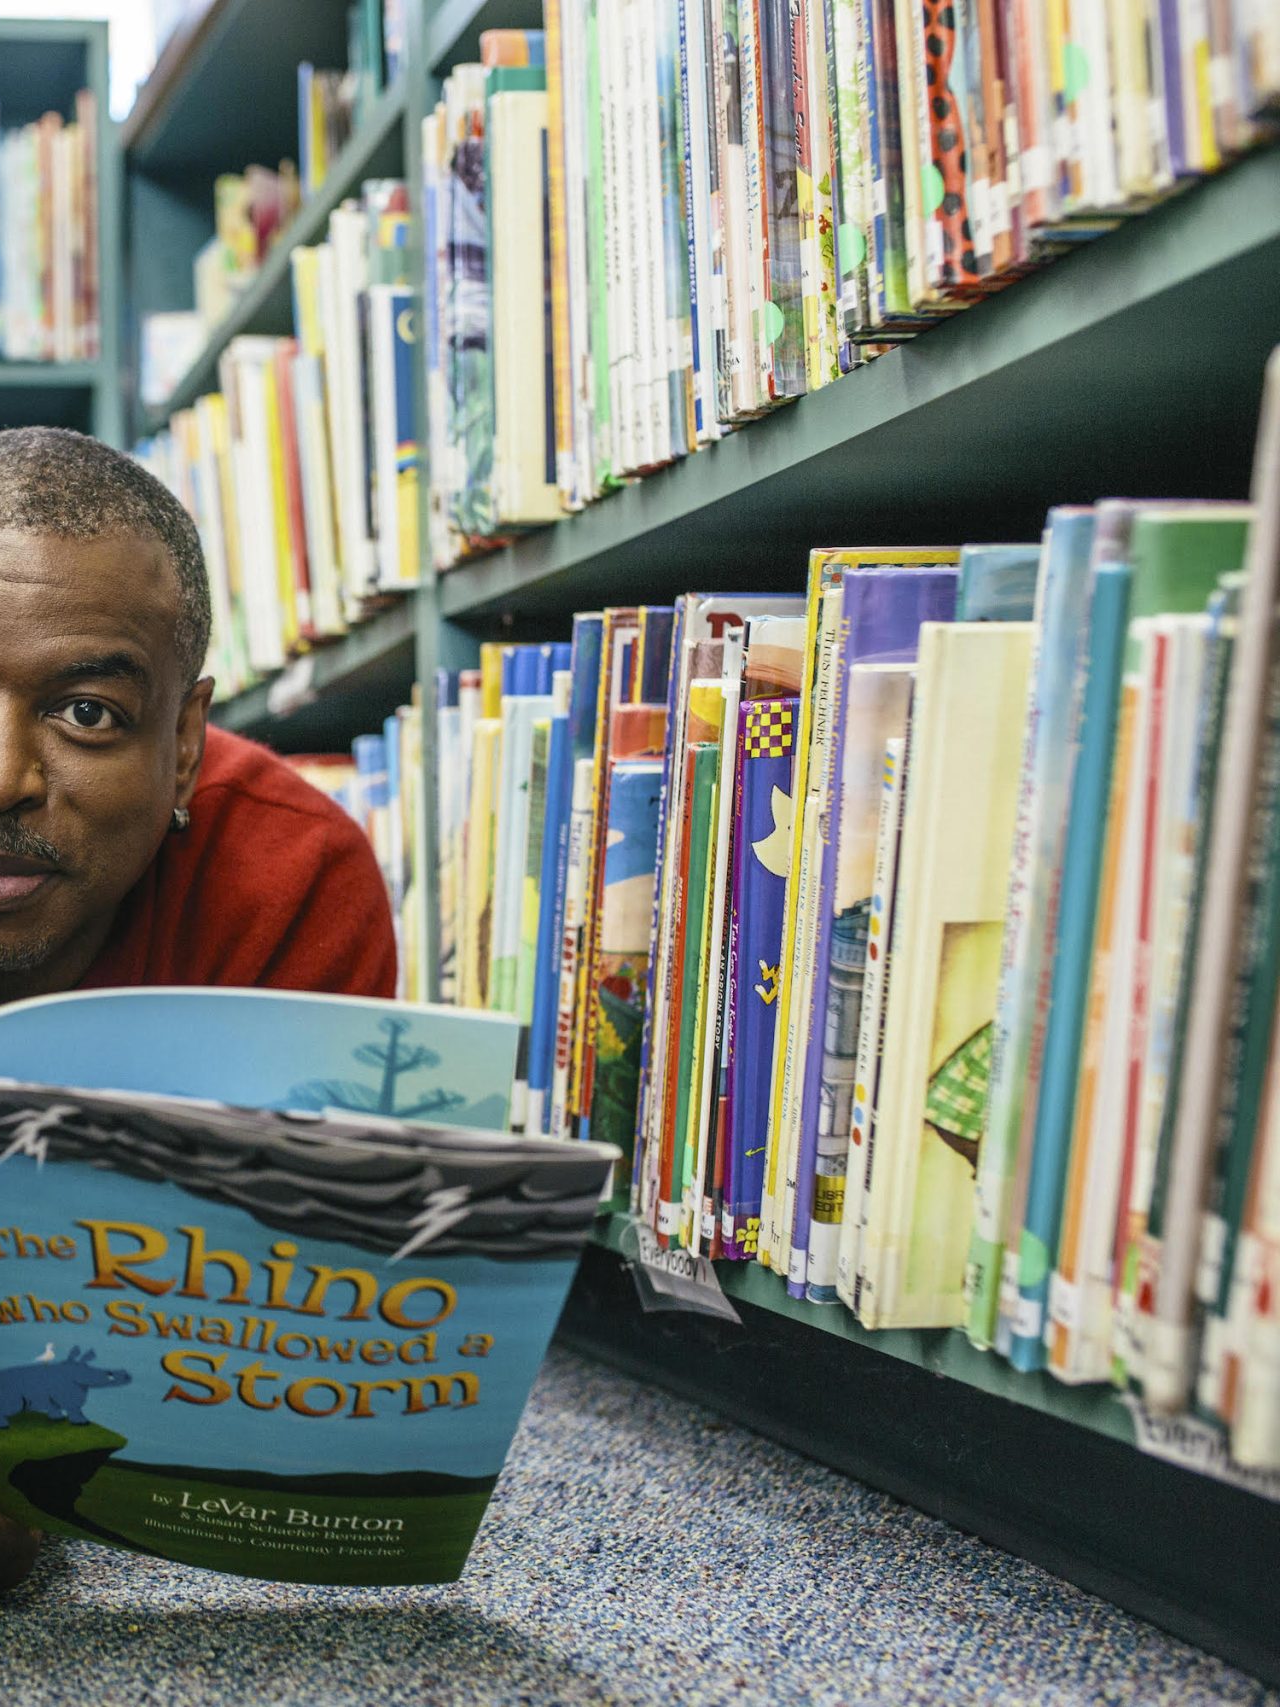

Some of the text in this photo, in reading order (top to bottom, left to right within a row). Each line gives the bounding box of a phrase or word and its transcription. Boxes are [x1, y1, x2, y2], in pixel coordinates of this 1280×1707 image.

[730, 923, 739, 948] Take
[716, 971, 725, 1012] ORIGIN
[728, 978, 737, 1006] Good
[713, 1015, 722, 1050] STORY
[727, 1009, 736, 1041] Knight
[75, 1219, 460, 1331] Rhino
[105, 1300, 439, 1366] Swallowed
[458, 1332, 495, 1358] a
[161, 1348, 480, 1420] Storm
[152, 1491, 405, 1532] by LeVar Burton
[197, 1513, 243, 1529] Susan
[248, 1522, 320, 1539] Schaefer
[324, 1531, 401, 1542] Bernardo
[144, 1518, 406, 1556] Illustrations by Courtenay Fletcher
